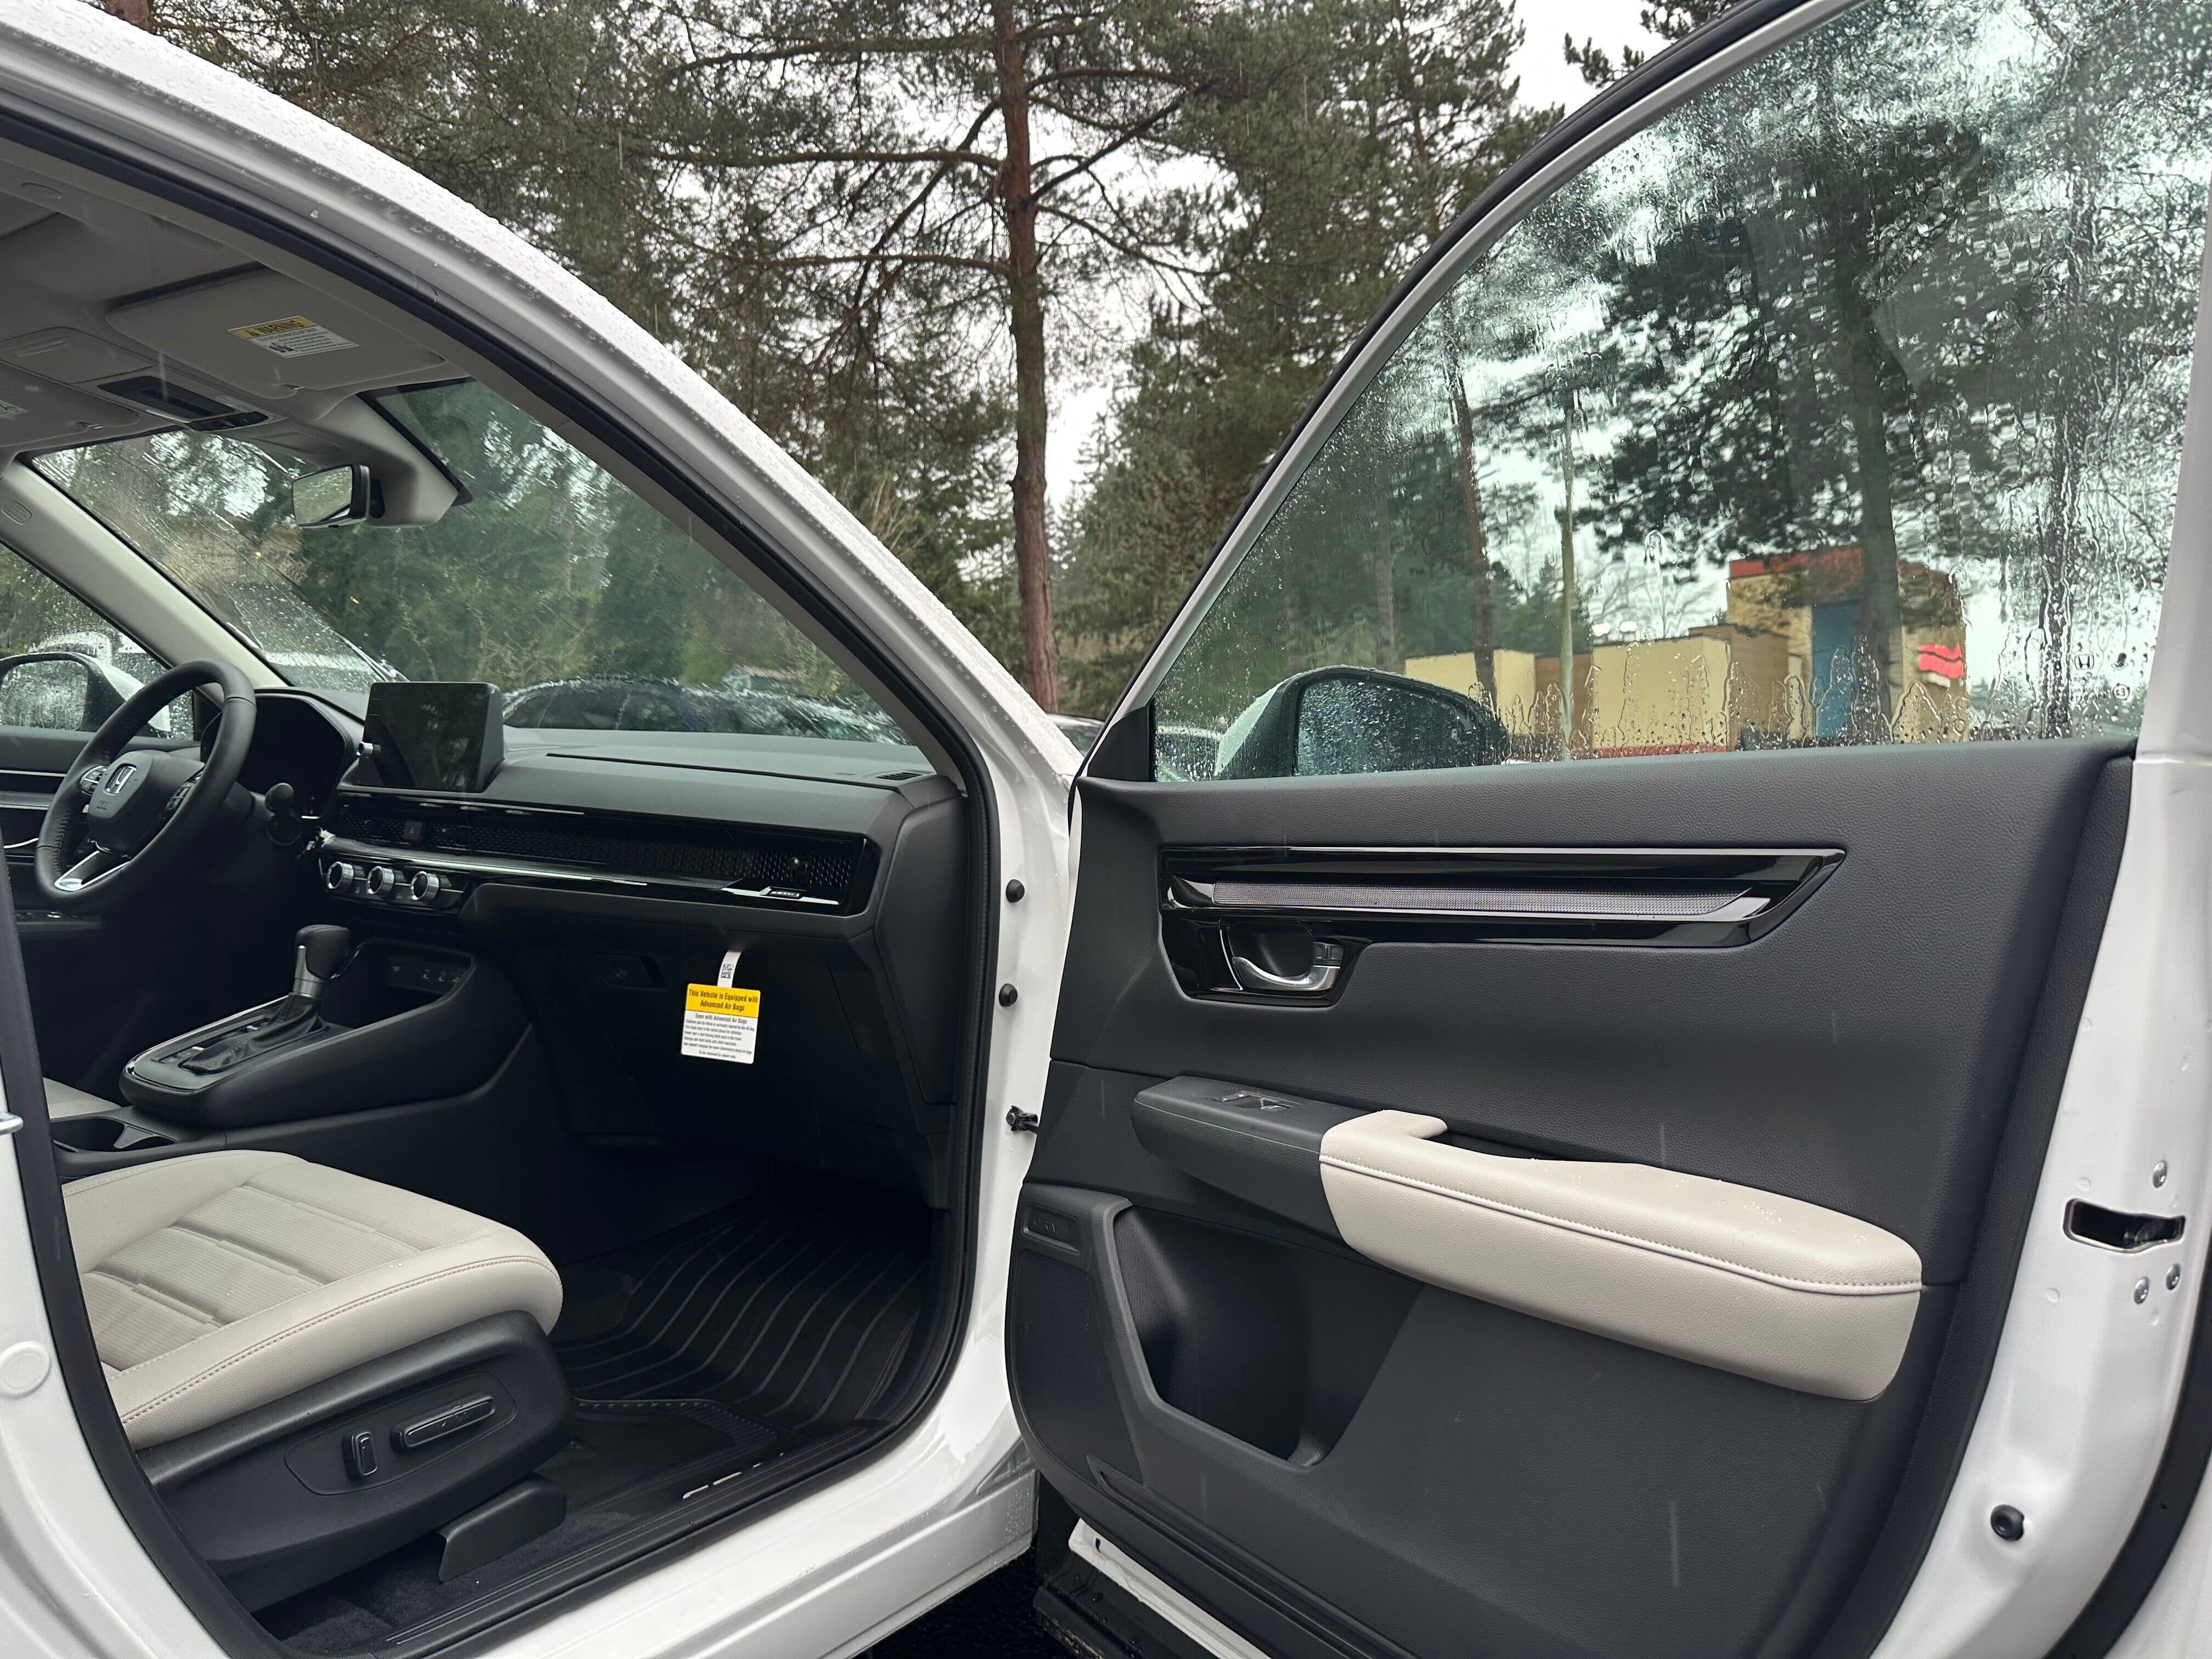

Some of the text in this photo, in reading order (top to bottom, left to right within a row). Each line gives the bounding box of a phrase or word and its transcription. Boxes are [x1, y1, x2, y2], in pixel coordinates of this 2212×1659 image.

[700, 990, 718, 998] Vehicle
[725, 993, 747, 1002] Equipped
[700, 1000, 724, 1009] Advanced
[733, 1003, 745, 1012] Bags
